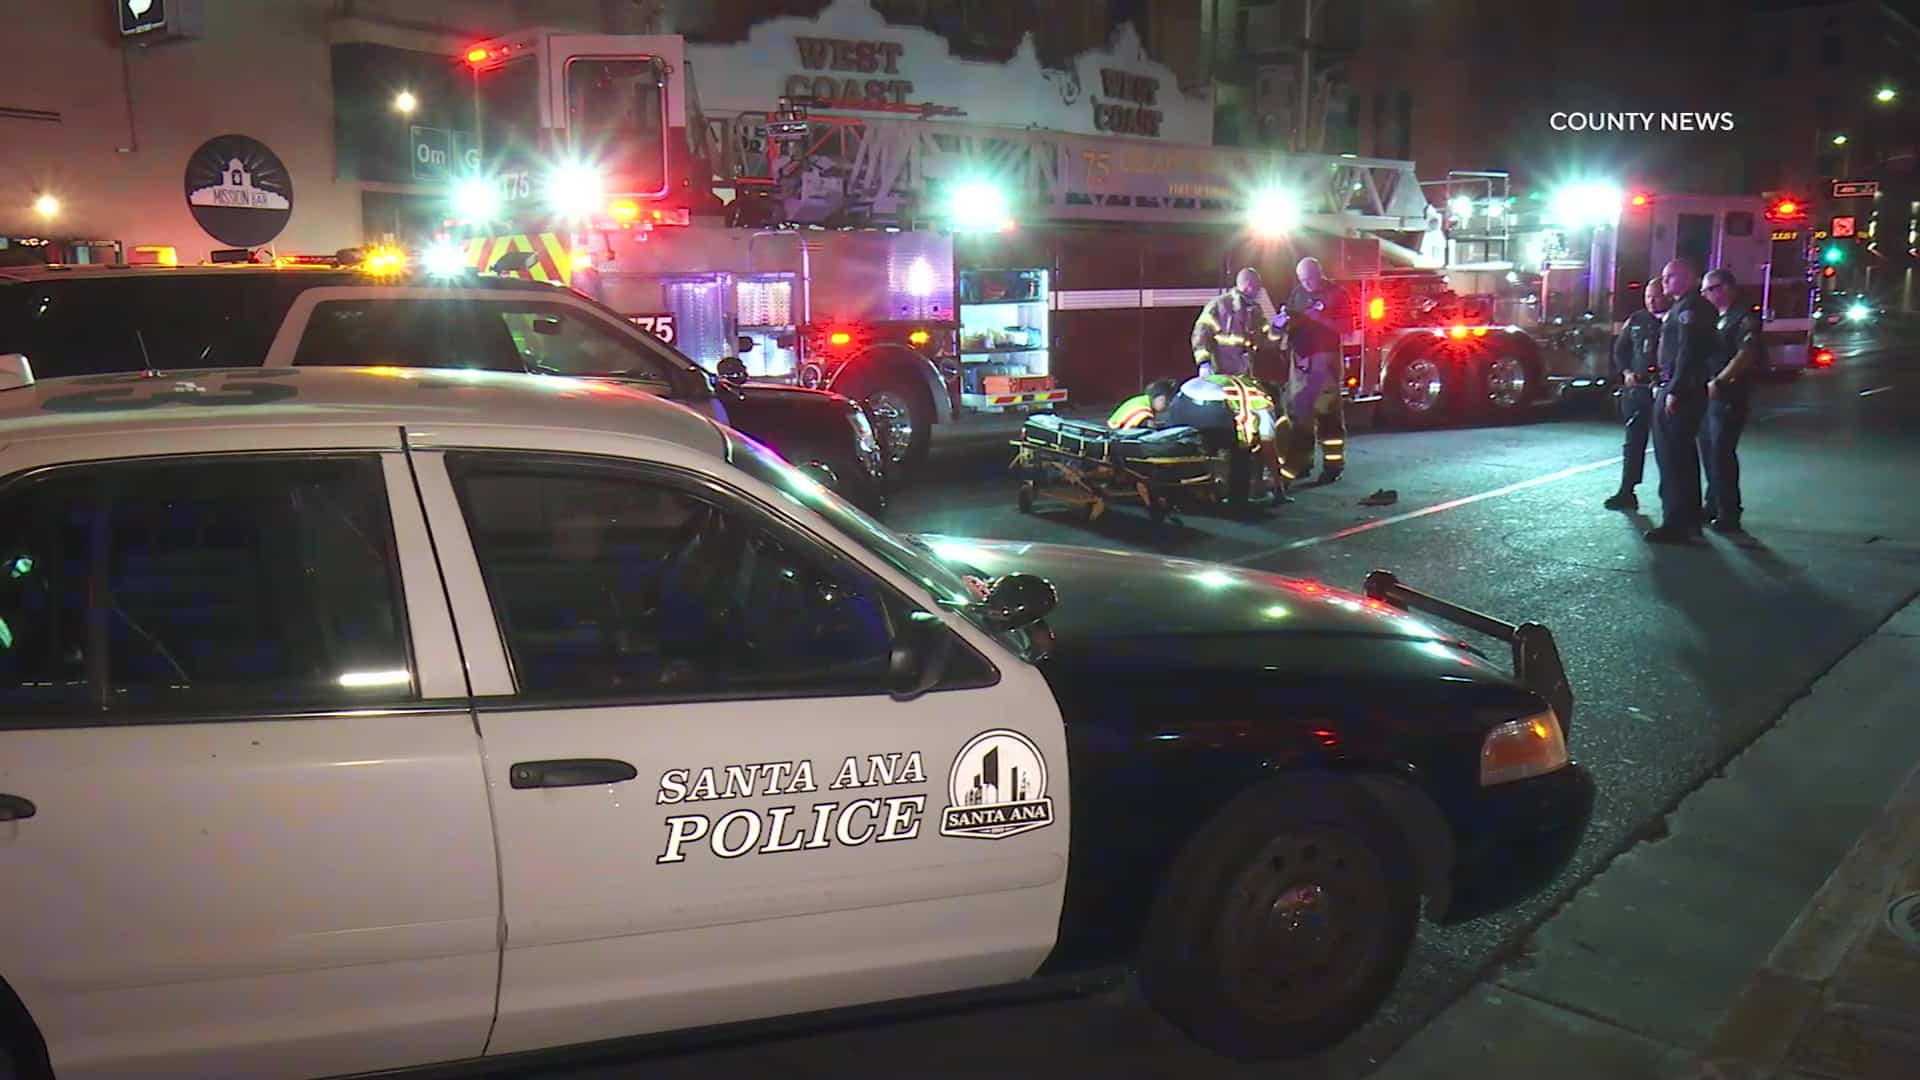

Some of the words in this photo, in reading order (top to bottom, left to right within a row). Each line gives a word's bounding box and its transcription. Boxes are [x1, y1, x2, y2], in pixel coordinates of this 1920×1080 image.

[794, 37, 904, 74] WEST
[785, 74, 914, 105] COAST
[628, 316, 674, 343] 75
[656, 760, 818, 804] SANTA
[829, 751, 927, 790] ANA
[656, 794, 927, 864] POLICE
[948, 809, 1006, 826] SANTA
[1010, 805, 1047, 821] ANA
